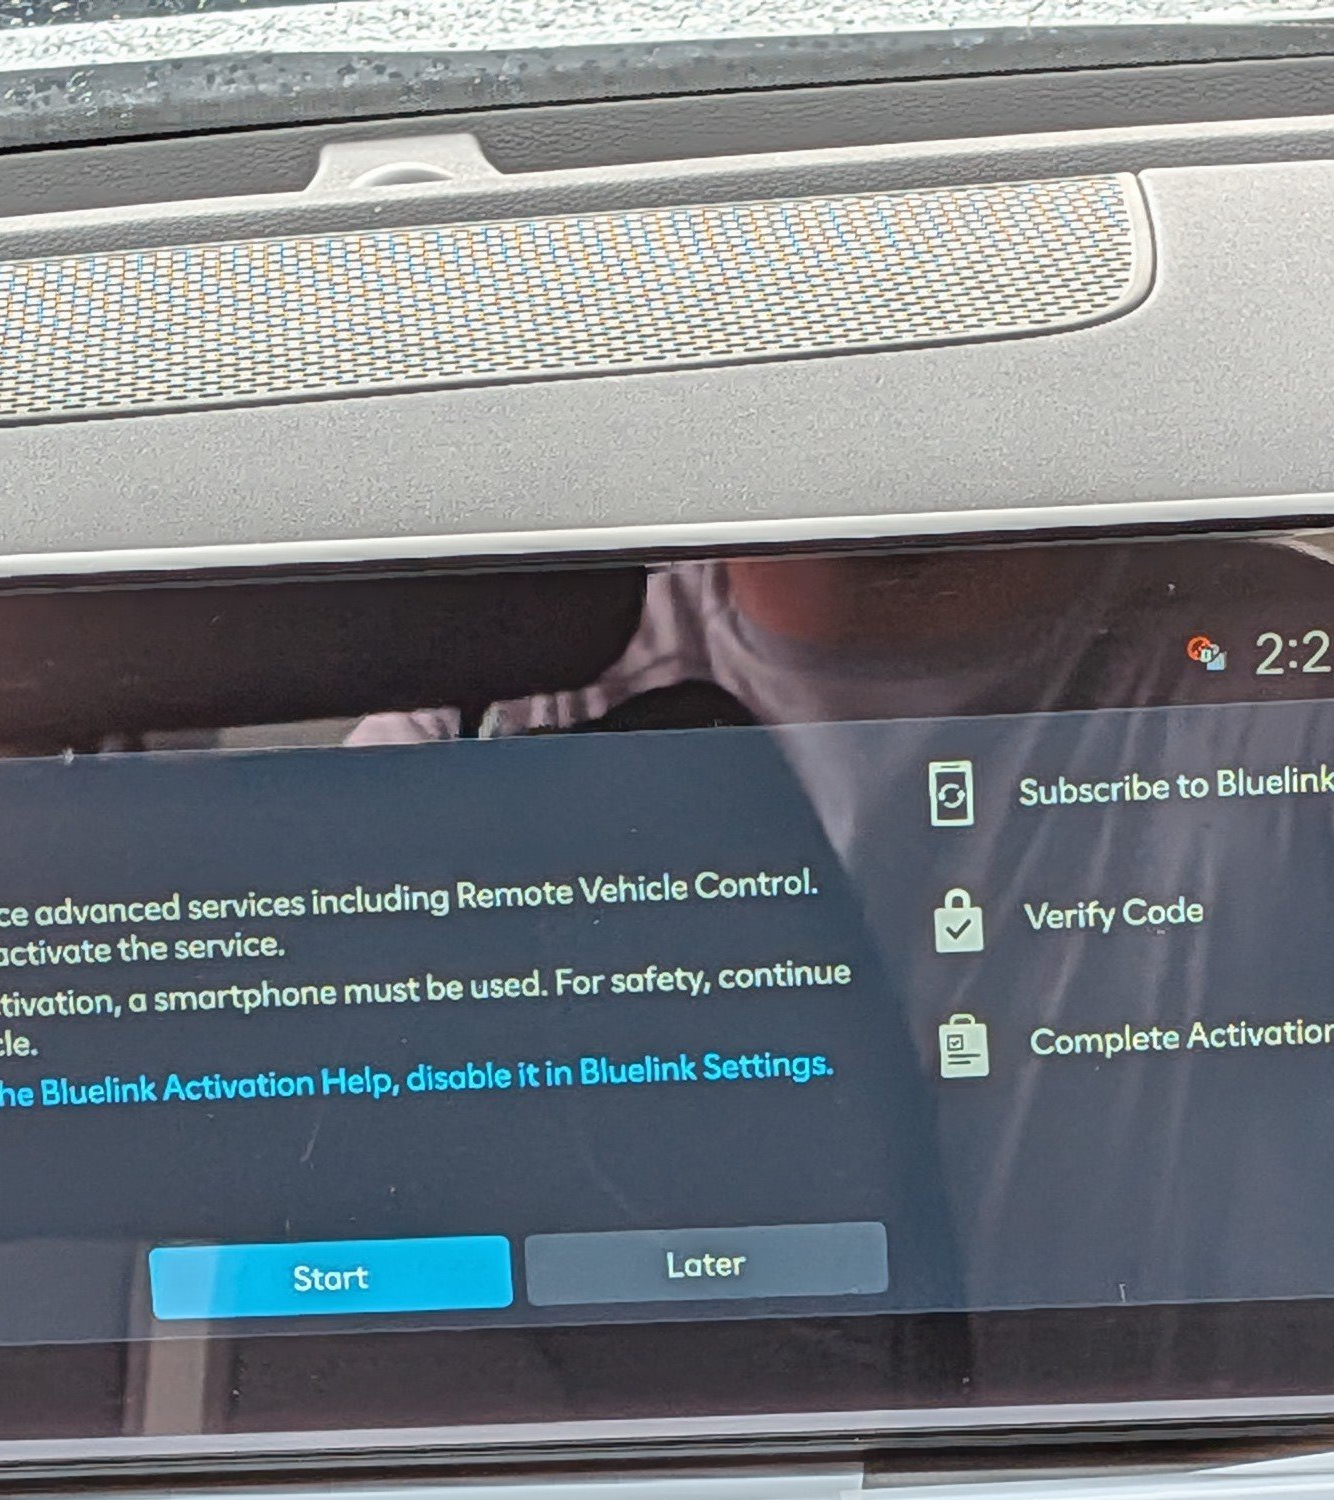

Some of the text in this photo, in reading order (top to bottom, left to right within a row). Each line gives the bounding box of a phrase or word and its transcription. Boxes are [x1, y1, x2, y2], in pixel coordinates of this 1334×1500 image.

[1020, 774, 1169, 805] Subscribe
[1177, 775, 1209, 798] to
[35, 893, 180, 925] advanced
[189, 890, 305, 921] services
[312, 884, 449, 916] including
[457, 882, 573, 908] Remote
[579, 873, 688, 903] Vehicle
[695, 868, 817, 898] Control.
[1024, 896, 1203, 933] Verify Code
[117, 934, 167, 961] the
[175, 932, 284, 959] service.
[129, 994, 147, 1012] a
[155, 981, 336, 1014] smartphone
[345, 978, 420, 1004] must
[427, 974, 463, 1000] be
[471, 970, 547, 998] used.
[556, 969, 605, 995] For
[611, 966, 710, 996] safety,
[719, 960, 850, 988] continue
[1031, 1024, 1179, 1058] Complete
[41, 1075, 157, 1105] Bluelink
[163, 1072, 314, 1101] Activation
[321, 1066, 399, 1099] Help,
[407, 1062, 511, 1091] disable
[518, 1062, 540, 1087] it
[546, 1061, 572, 1086] in
[580, 1054, 697, 1084] Bluelink
[703, 1052, 833, 1082] Settings.
[294, 1266, 368, 1291] Start
[667, 1252, 746, 1278] Later
